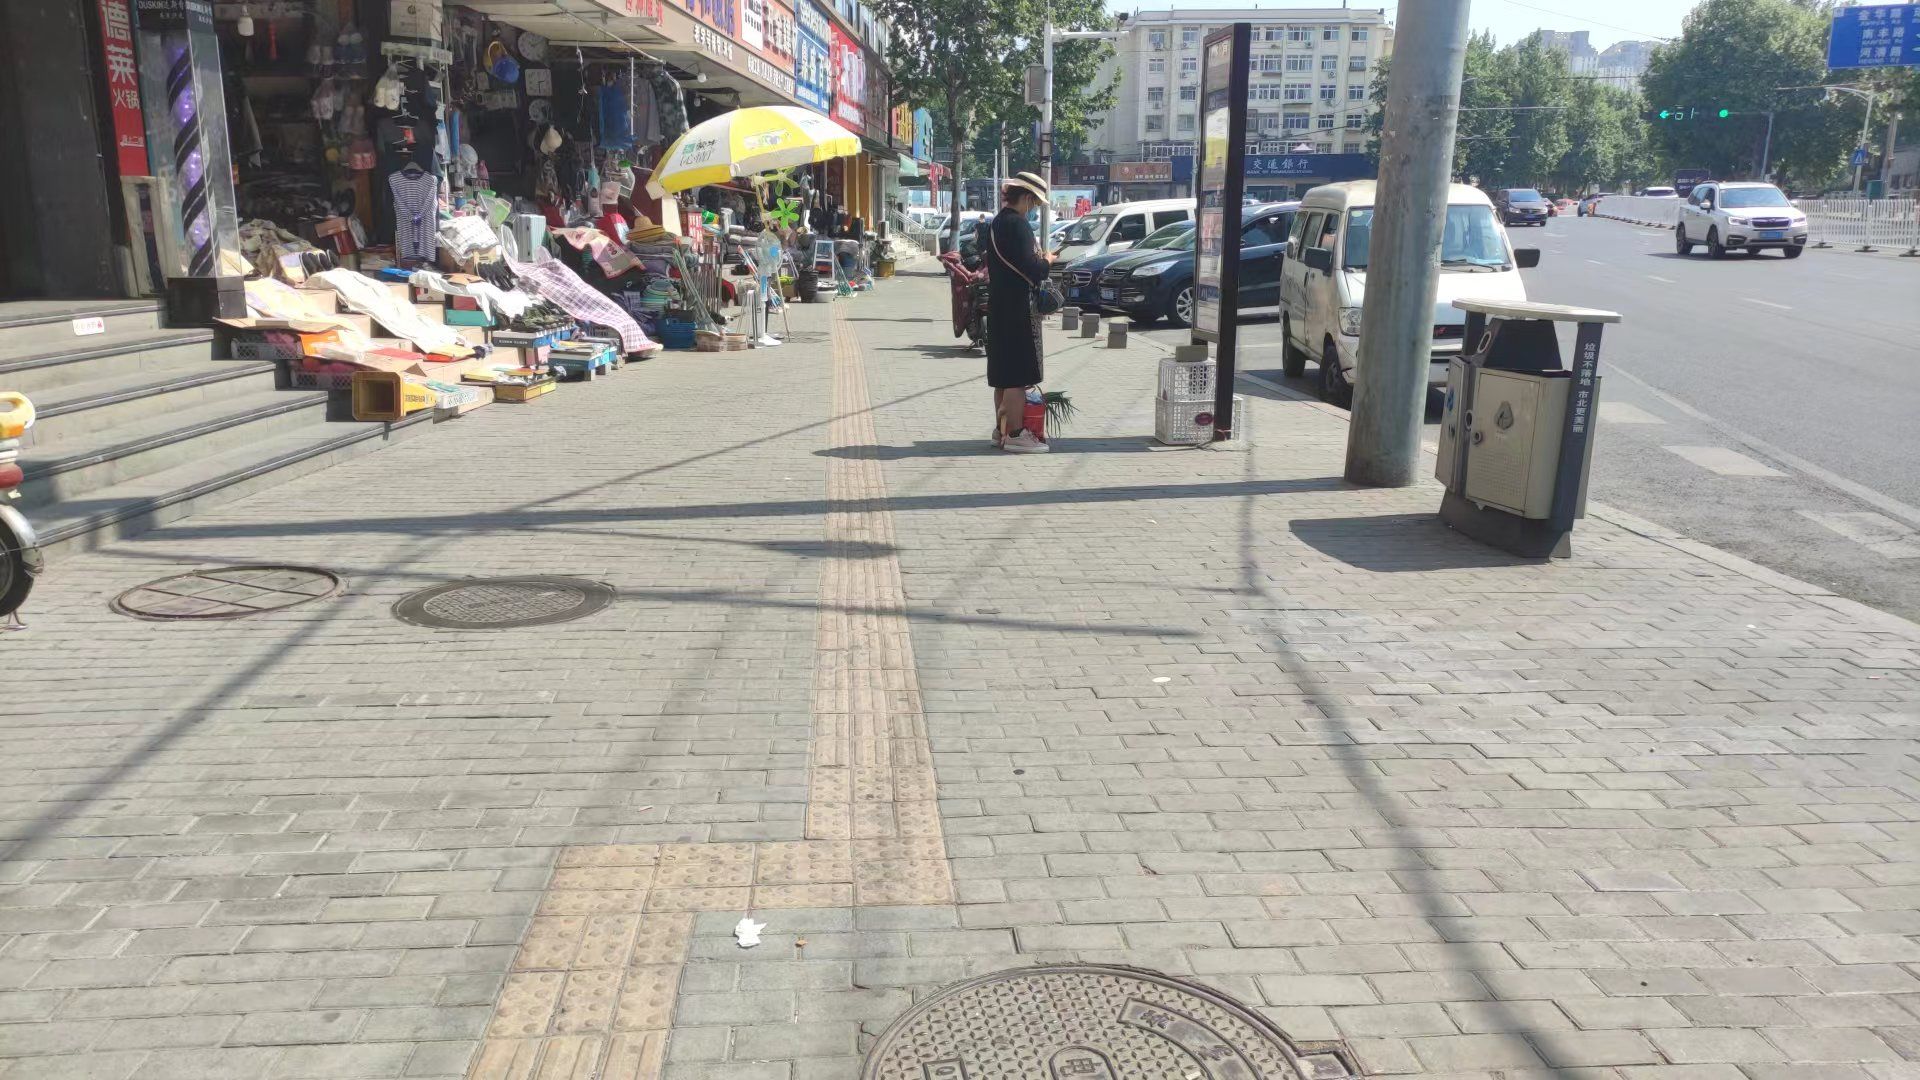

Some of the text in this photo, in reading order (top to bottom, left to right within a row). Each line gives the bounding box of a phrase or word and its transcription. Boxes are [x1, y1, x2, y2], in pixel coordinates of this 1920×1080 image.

[113, 88, 140, 109] 火锅
[1572, 342, 1596, 433] 垃圾不落地 市北更美丽
